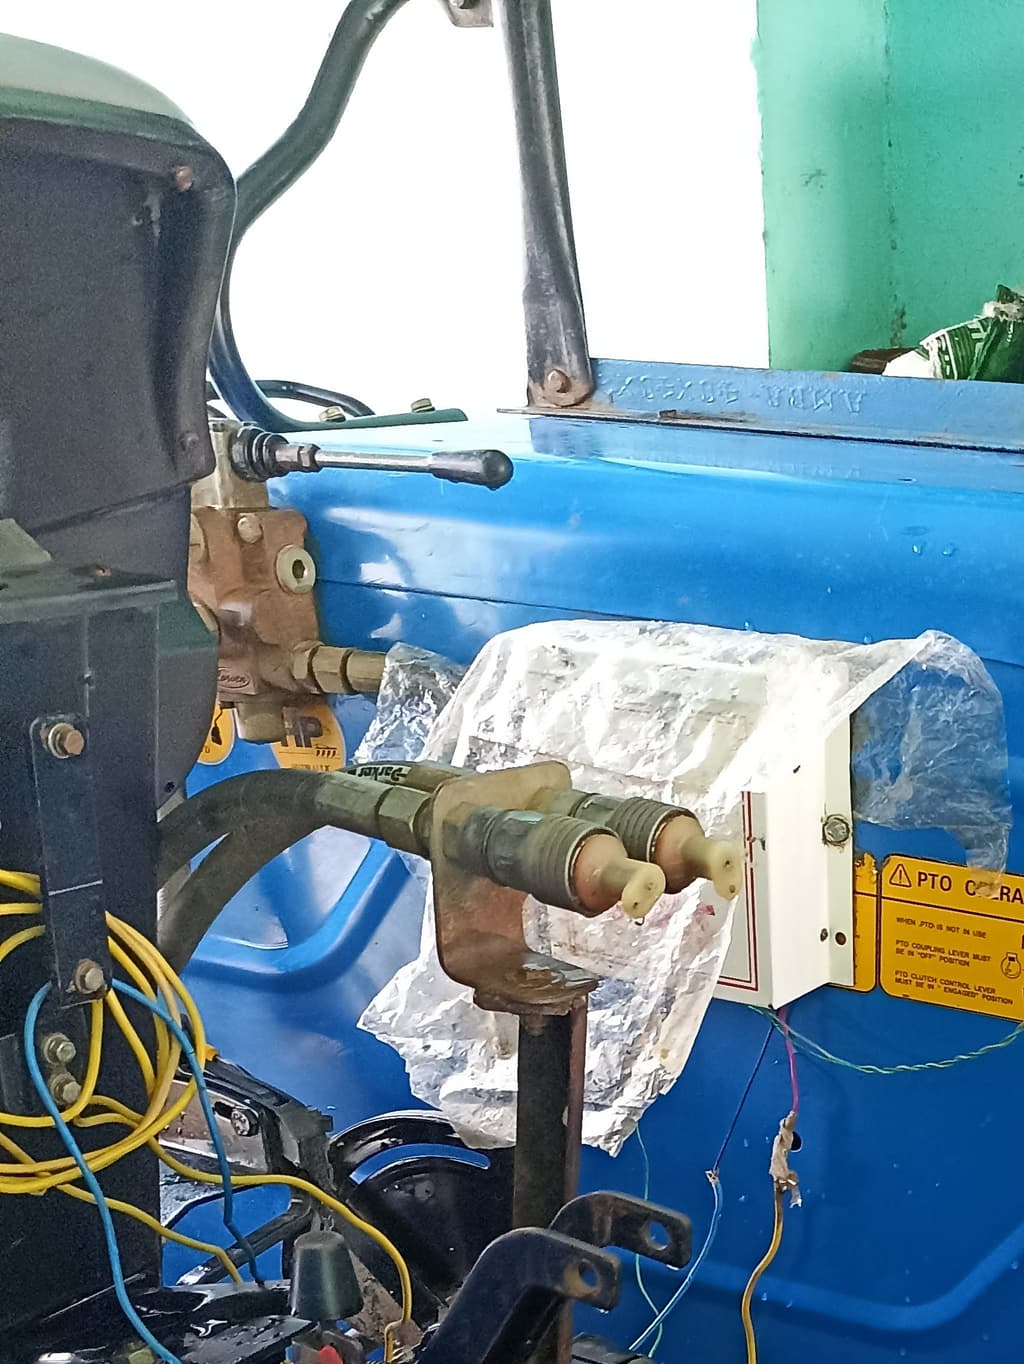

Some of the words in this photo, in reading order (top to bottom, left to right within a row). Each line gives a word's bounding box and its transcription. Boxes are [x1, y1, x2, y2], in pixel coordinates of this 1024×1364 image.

[357, 766, 409, 782] Parker
[917, 871, 952, 892] PTO
[896, 917, 916, 926] WHEN
[946, 925, 960, 934] NOT
[963, 928, 970, 936] IN
[895, 939, 909, 948] PTO
[911, 942, 945, 954] COUPLING
[948, 950, 970, 959] LEVER
[972, 953, 991, 962] MUST
[939, 955, 970, 967] POSITION
[895, 970, 909, 978] PTO
[910, 972, 937, 983] CLUTCH
[940, 978, 970, 990] CONTROL
[974, 985, 996, 994] LEVER
[895, 977, 912, 986] MUST
[981, 990, 1013, 1005] POSITION
